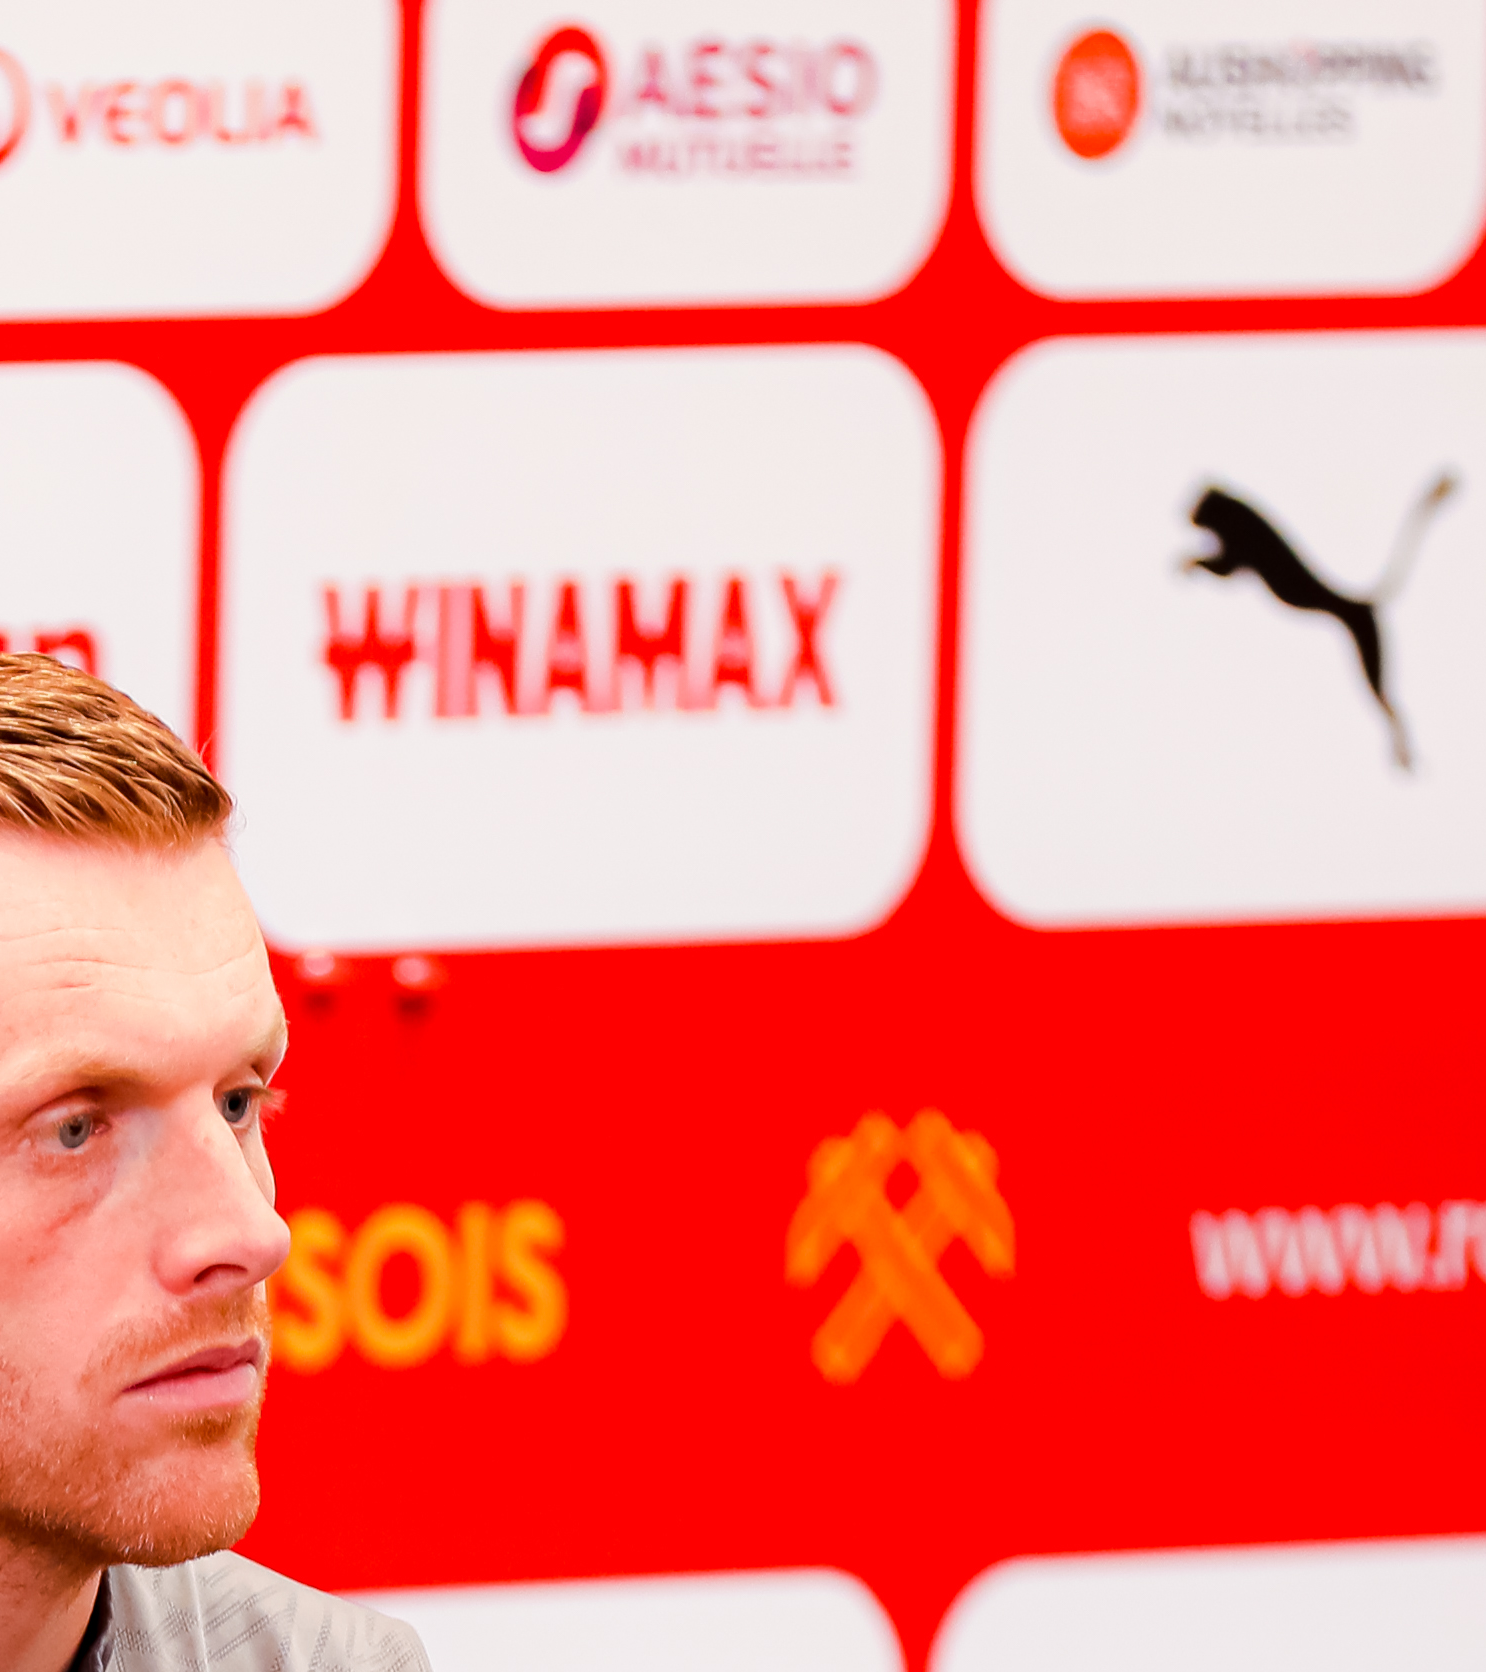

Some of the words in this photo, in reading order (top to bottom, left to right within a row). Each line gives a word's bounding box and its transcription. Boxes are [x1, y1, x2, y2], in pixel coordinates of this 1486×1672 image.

[47, 78, 319, 150] VEOLIA
[321, 574, 837, 722] WINAMAX
[269, 1197, 567, 1372] SOIS
